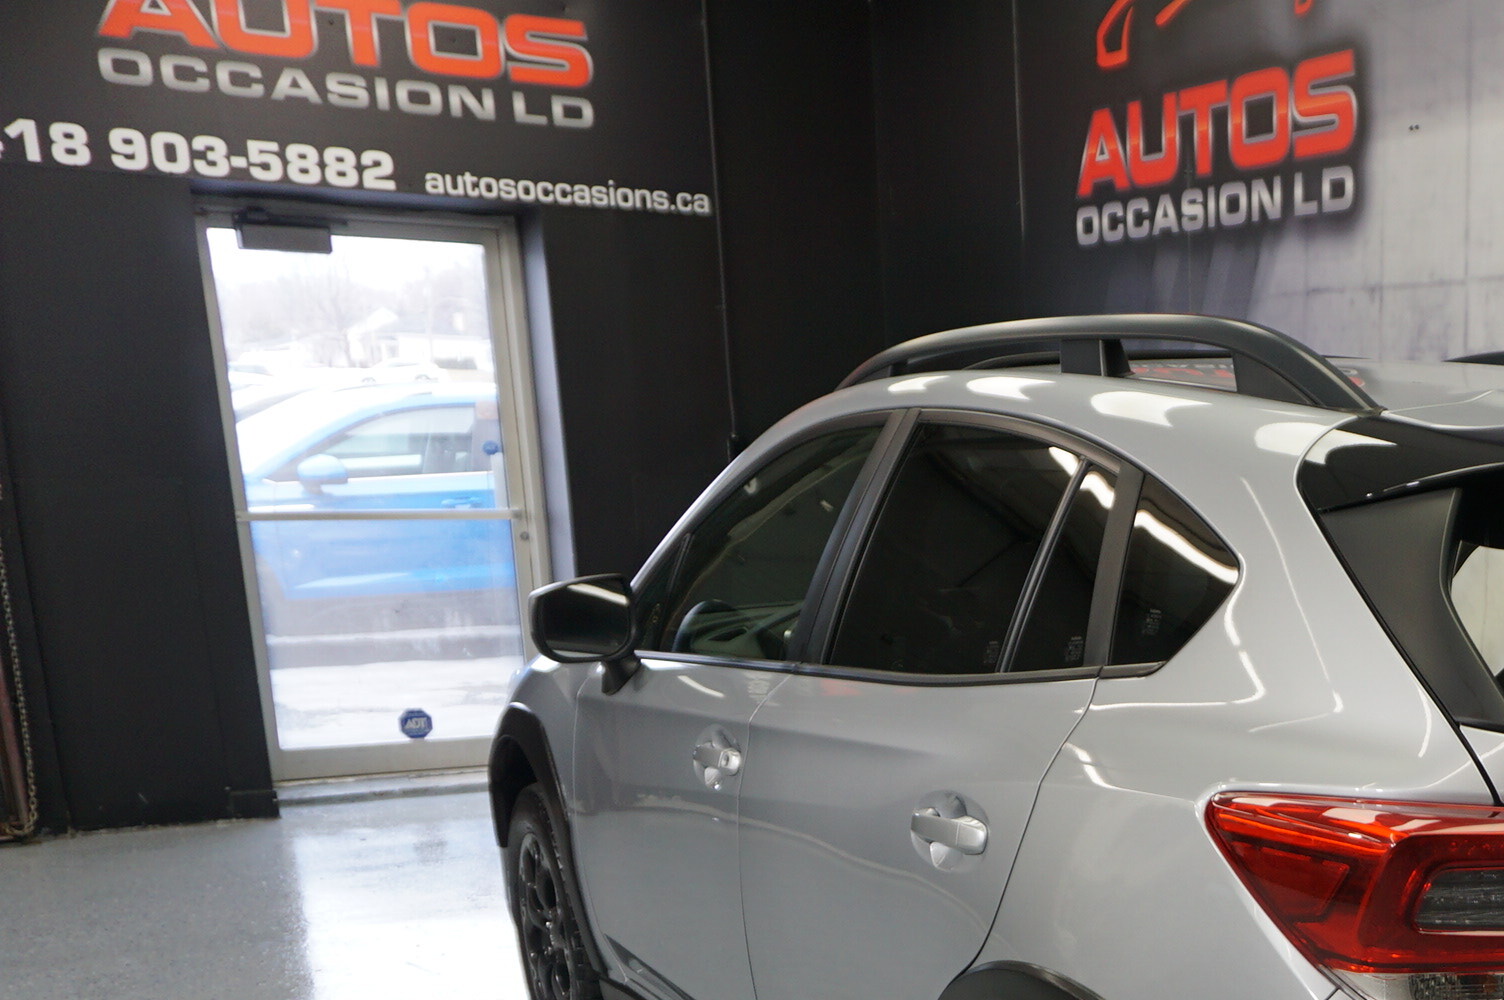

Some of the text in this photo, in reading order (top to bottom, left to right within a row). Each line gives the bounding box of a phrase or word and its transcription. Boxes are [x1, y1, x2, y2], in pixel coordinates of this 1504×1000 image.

[98, 0, 595, 88] AUTOS
[98, 48, 595, 129] OCCASION LD
[1077, 50, 1357, 197] AUTOS
[0, 117, 397, 191] 18 903-5882
[425, 168, 712, 215] autosoccasions.ca
[1076, 165, 1355, 246] OCCASION LD
